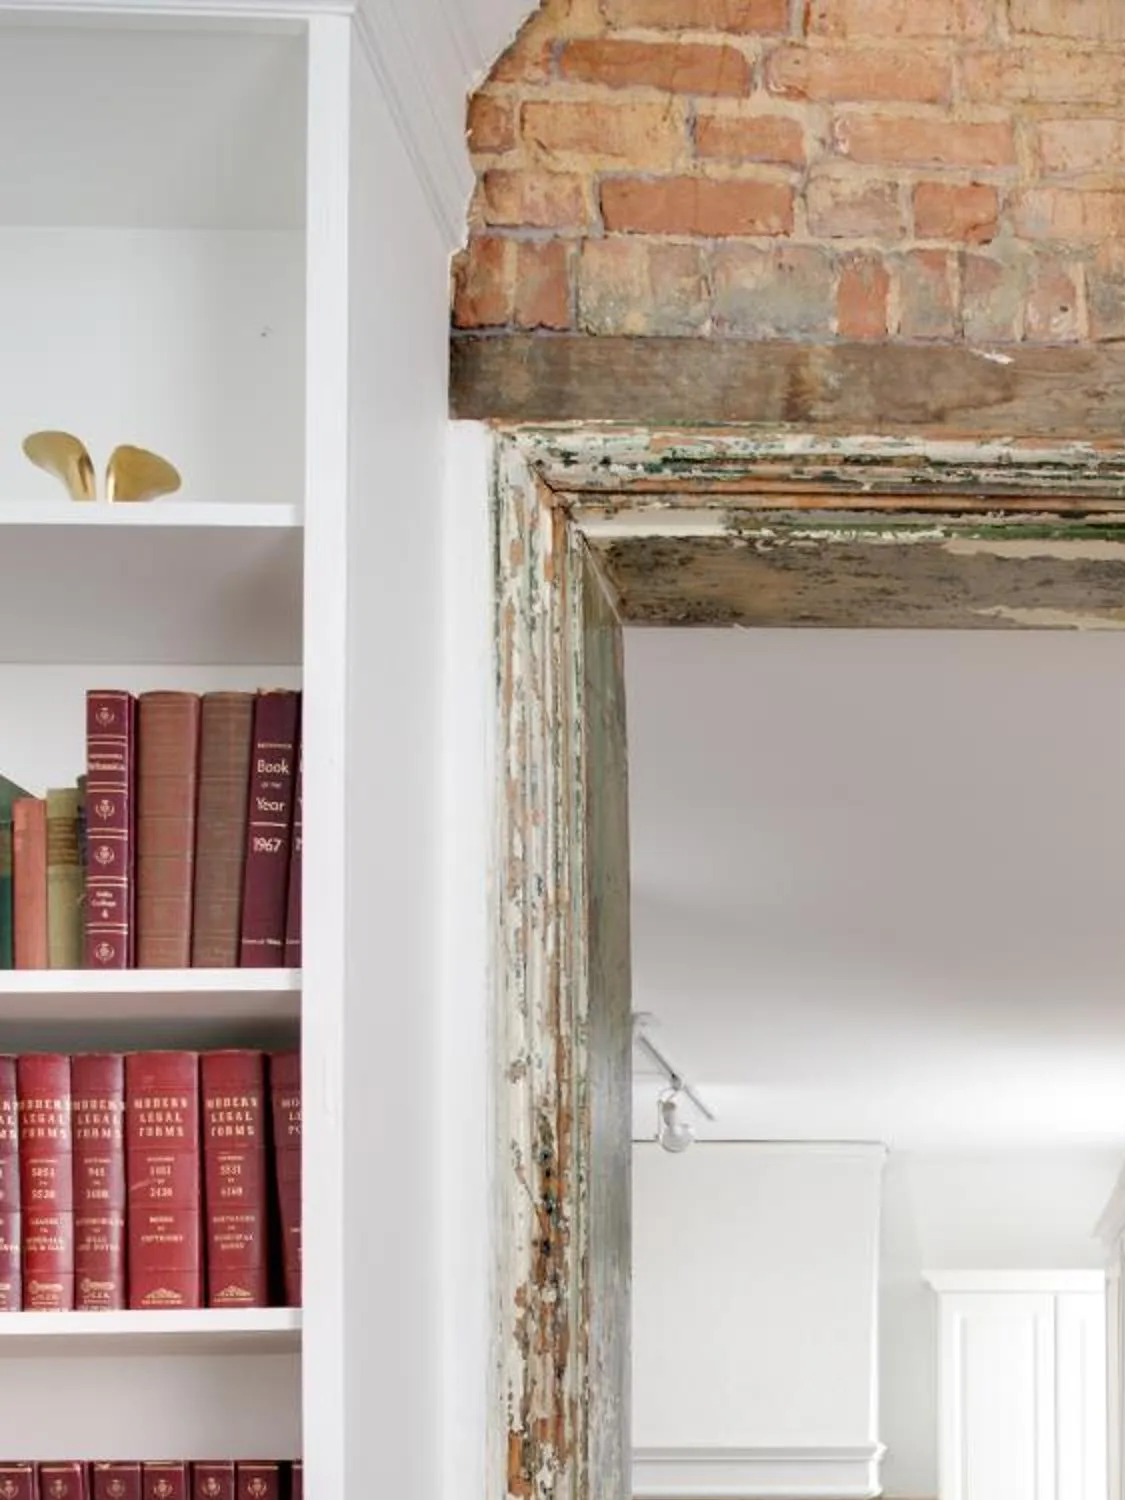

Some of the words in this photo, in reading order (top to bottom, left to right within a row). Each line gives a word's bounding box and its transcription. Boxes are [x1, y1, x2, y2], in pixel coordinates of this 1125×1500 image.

[257, 759, 289, 774] Book
[256, 797, 286, 812] Year
[253, 837, 282, 852] 1967
